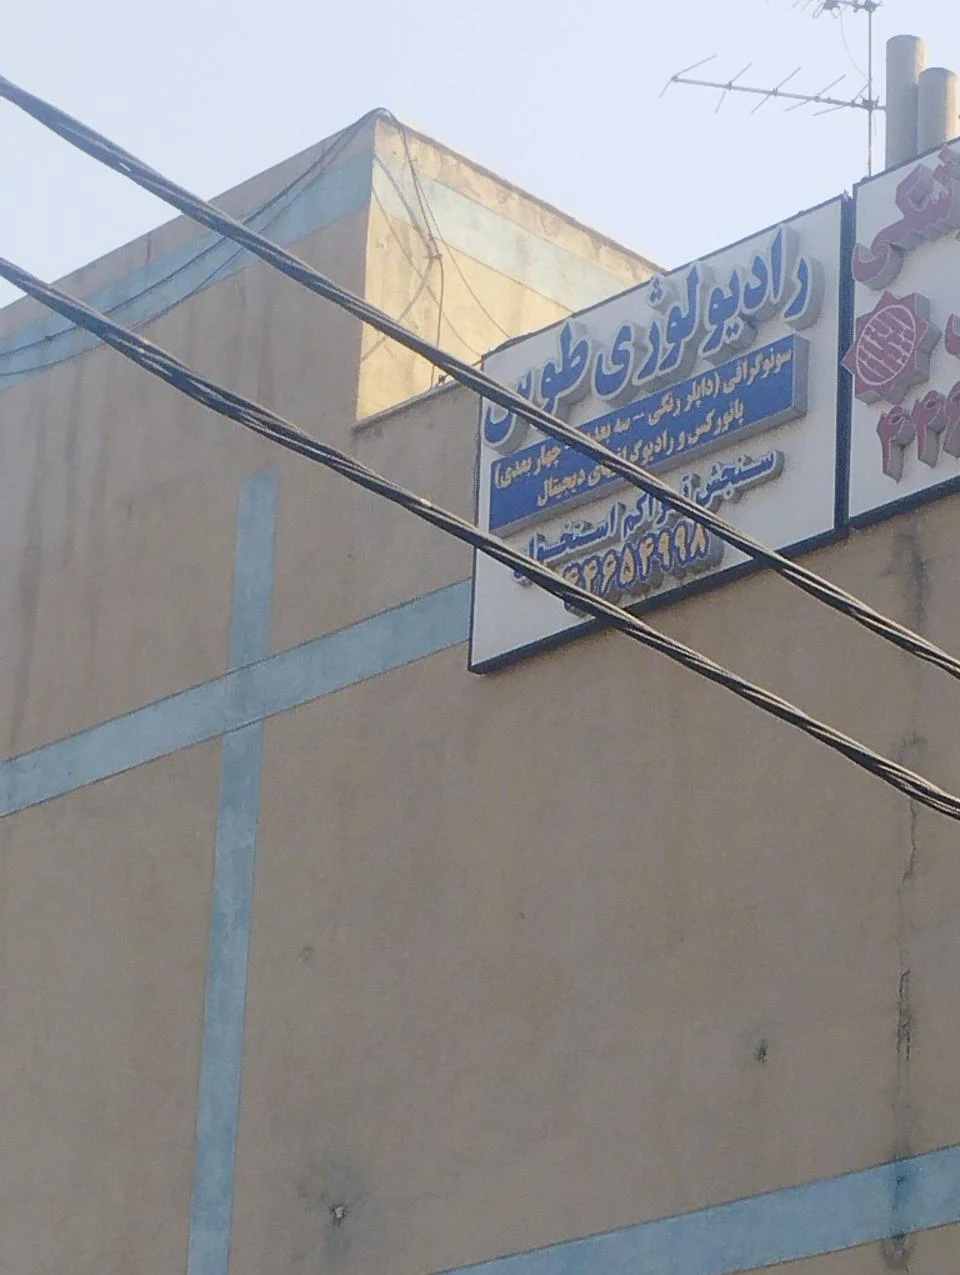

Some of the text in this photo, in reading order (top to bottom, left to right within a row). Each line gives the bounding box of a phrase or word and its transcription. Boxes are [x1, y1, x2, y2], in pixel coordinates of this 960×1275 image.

[484, 224, 817, 448] رادیولوژی طوس
[722, 347, 793, 393] سونوگرافی
[677, 434, 686, 451] و
[537, 468, 586, 506] دیجیتال
[699, 450, 778, 505] سنجش
[514, 502, 620, 584] استخوا
